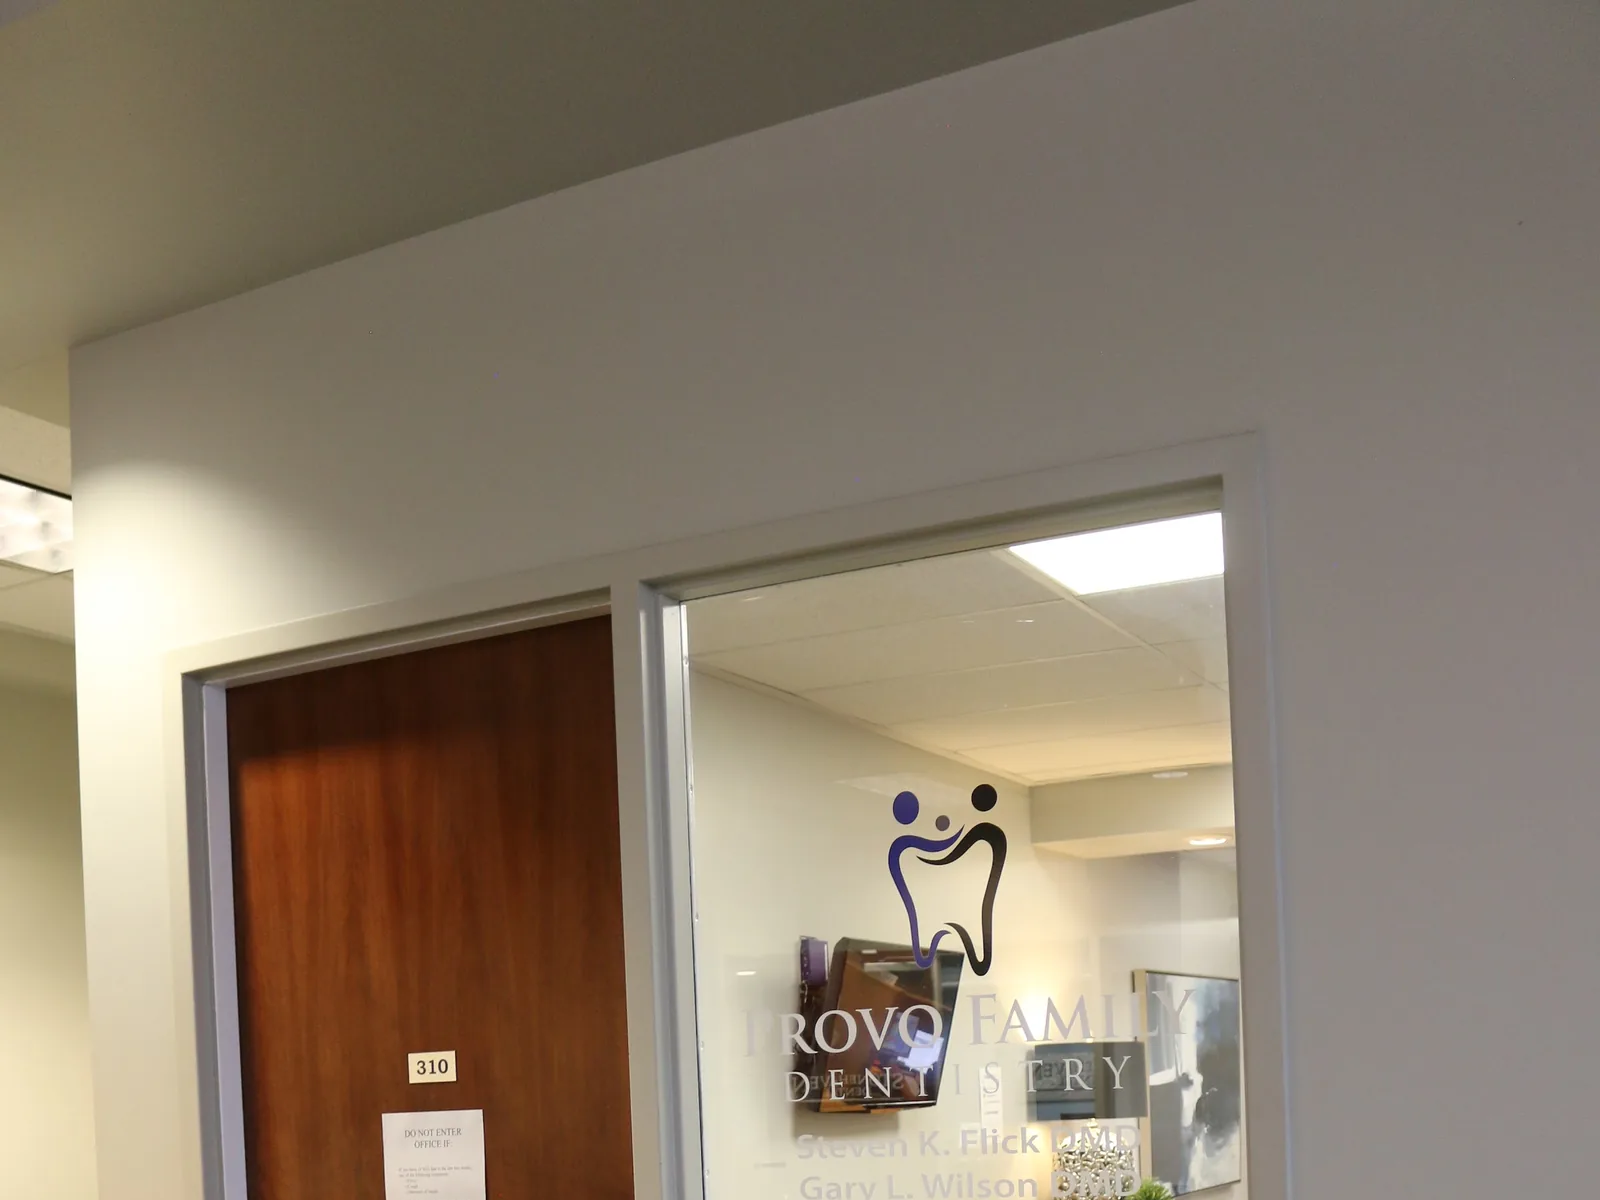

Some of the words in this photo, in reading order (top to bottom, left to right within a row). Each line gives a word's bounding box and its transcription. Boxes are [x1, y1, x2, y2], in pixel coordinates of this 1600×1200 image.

[745, 1005, 943, 1058] PROVO
[968, 989, 1196, 1045] FAMILY
[416, 1058, 449, 1075] 310
[785, 1056, 1131, 1102] DENTISTRY
[404, 1129, 417, 1138] DO
[418, 1128, 434, 1137] NOT
[436, 1127, 462, 1136] ENTER
[414, 1140, 442, 1148] OFFICE
[797, 1133, 908, 1160] Steven
[920, 1130, 950, 1156] K.
[960, 1127, 1039, 1155] Flick
[1052, 1124, 1140, 1153] DMD
[888, 1174, 913, 1199] L.
[922, 1171, 1038, 1198] Wilson
[1052, 1169, 1141, 1198] DMD
